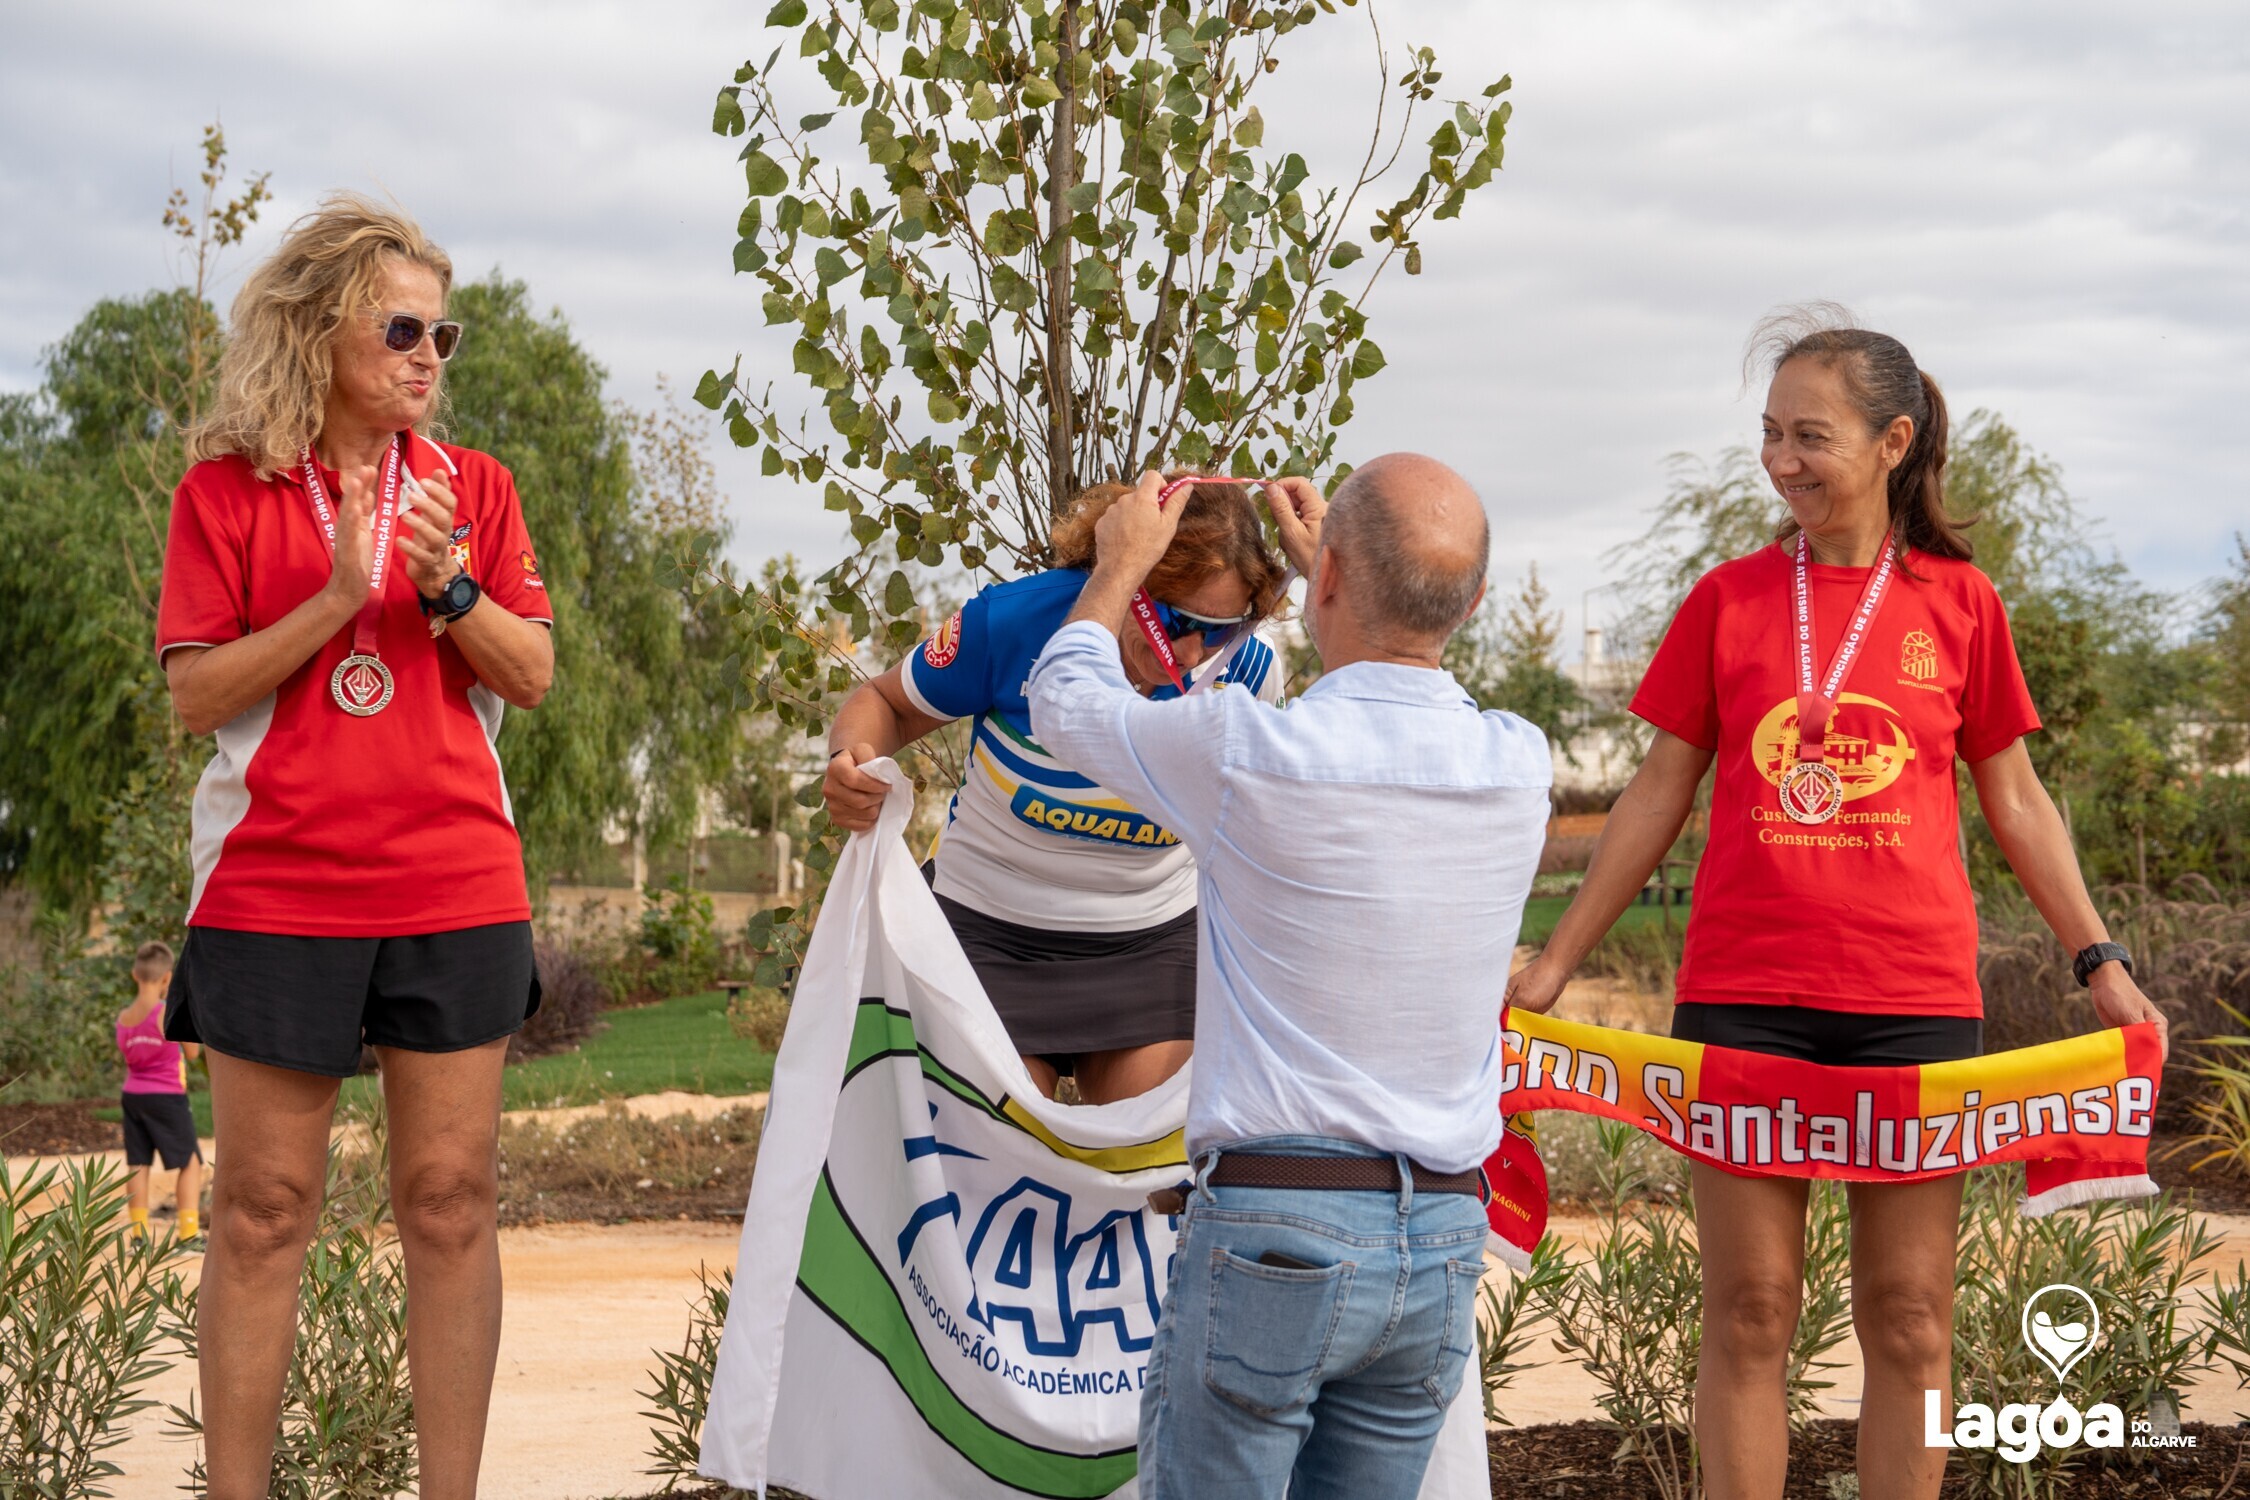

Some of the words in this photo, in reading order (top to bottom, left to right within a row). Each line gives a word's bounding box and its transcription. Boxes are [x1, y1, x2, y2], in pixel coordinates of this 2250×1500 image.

[304, 463, 331, 521] ATLETISMO
[323, 523, 336, 540] DO
[384, 450, 400, 500] ATLETISMO
[382, 502, 394, 516] DE
[370, 518, 391, 589] ASSOCIAÇÃO
[1796, 565, 1809, 622] ATLETISMO
[1137, 602, 1151, 619] DO
[1146, 620, 1175, 667] ALGARVE
[1799, 625, 1810, 640] DO
[1823, 632, 1861, 700] ASSOCIAÇÃO
[1853, 615, 1868, 632] DE
[1861, 561, 1892, 616] ATLETISMO
[1885, 546, 1896, 561] DO
[1800, 643, 1813, 692] ALGARVE
[1781, 774, 1804, 820] ASSOCIAÇÃO
[1796, 763, 1838, 783] ATLETISMO
[1820, 788, 1843, 820] ALGARVE
[1833, 807, 1912, 825] Fernandes
[1758, 828, 1870, 851] Construções,
[1874, 830, 1905, 847] S.A.
[1642, 1062, 2154, 1173] Santaluziense
[1491, 1190, 1532, 1223] MAGNINI
[908, 1264, 1001, 1373] ASSOCIAÇÃO
[1002, 1358, 1133, 1395] ACADÉMICA
